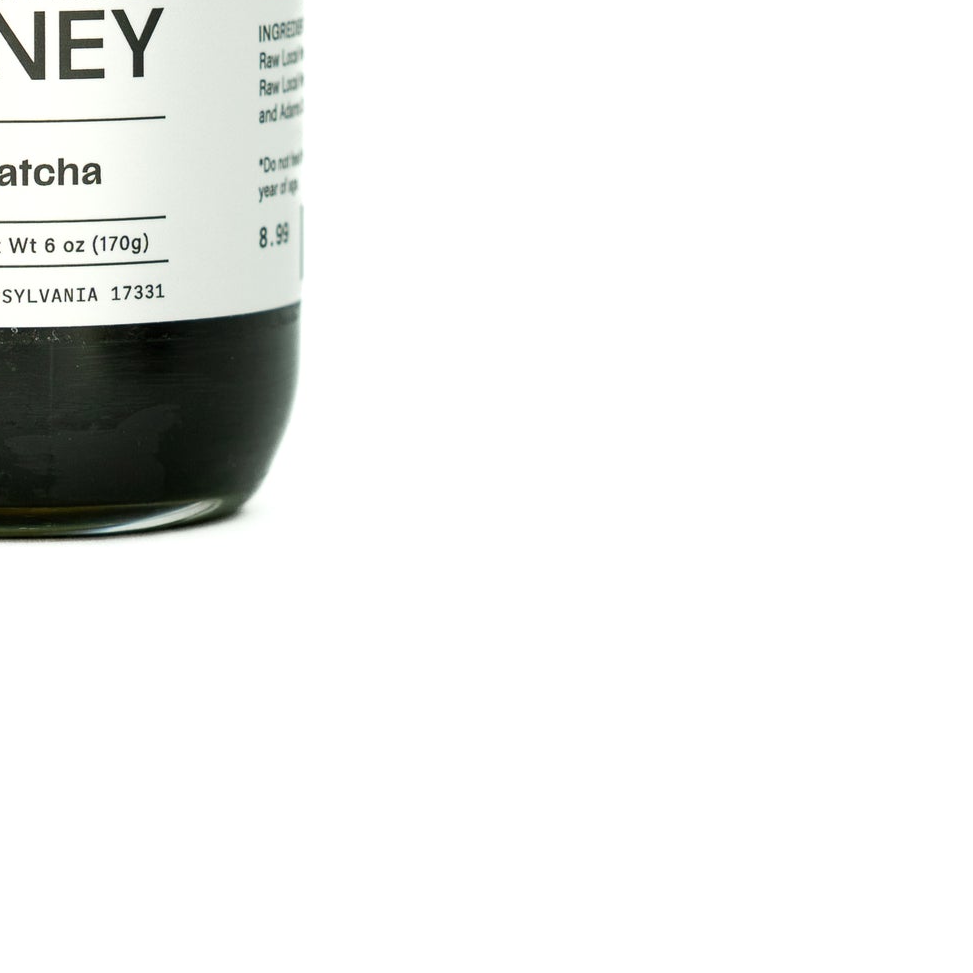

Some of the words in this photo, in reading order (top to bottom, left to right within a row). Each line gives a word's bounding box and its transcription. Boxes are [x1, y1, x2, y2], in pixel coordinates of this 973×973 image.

[259, 52, 280, 69] Raw
[259, 79, 280, 96] Raw
[258, 103, 278, 123] and
[258, 184, 278, 203] year
[8, 237, 37, 254] Wt
[44, 237, 56, 253] 6
[63, 240, 85, 253] oz
[92, 232, 149, 256] (170g)
[258, 222, 289, 248] 8.99
[111, 283, 165, 301] 17331
